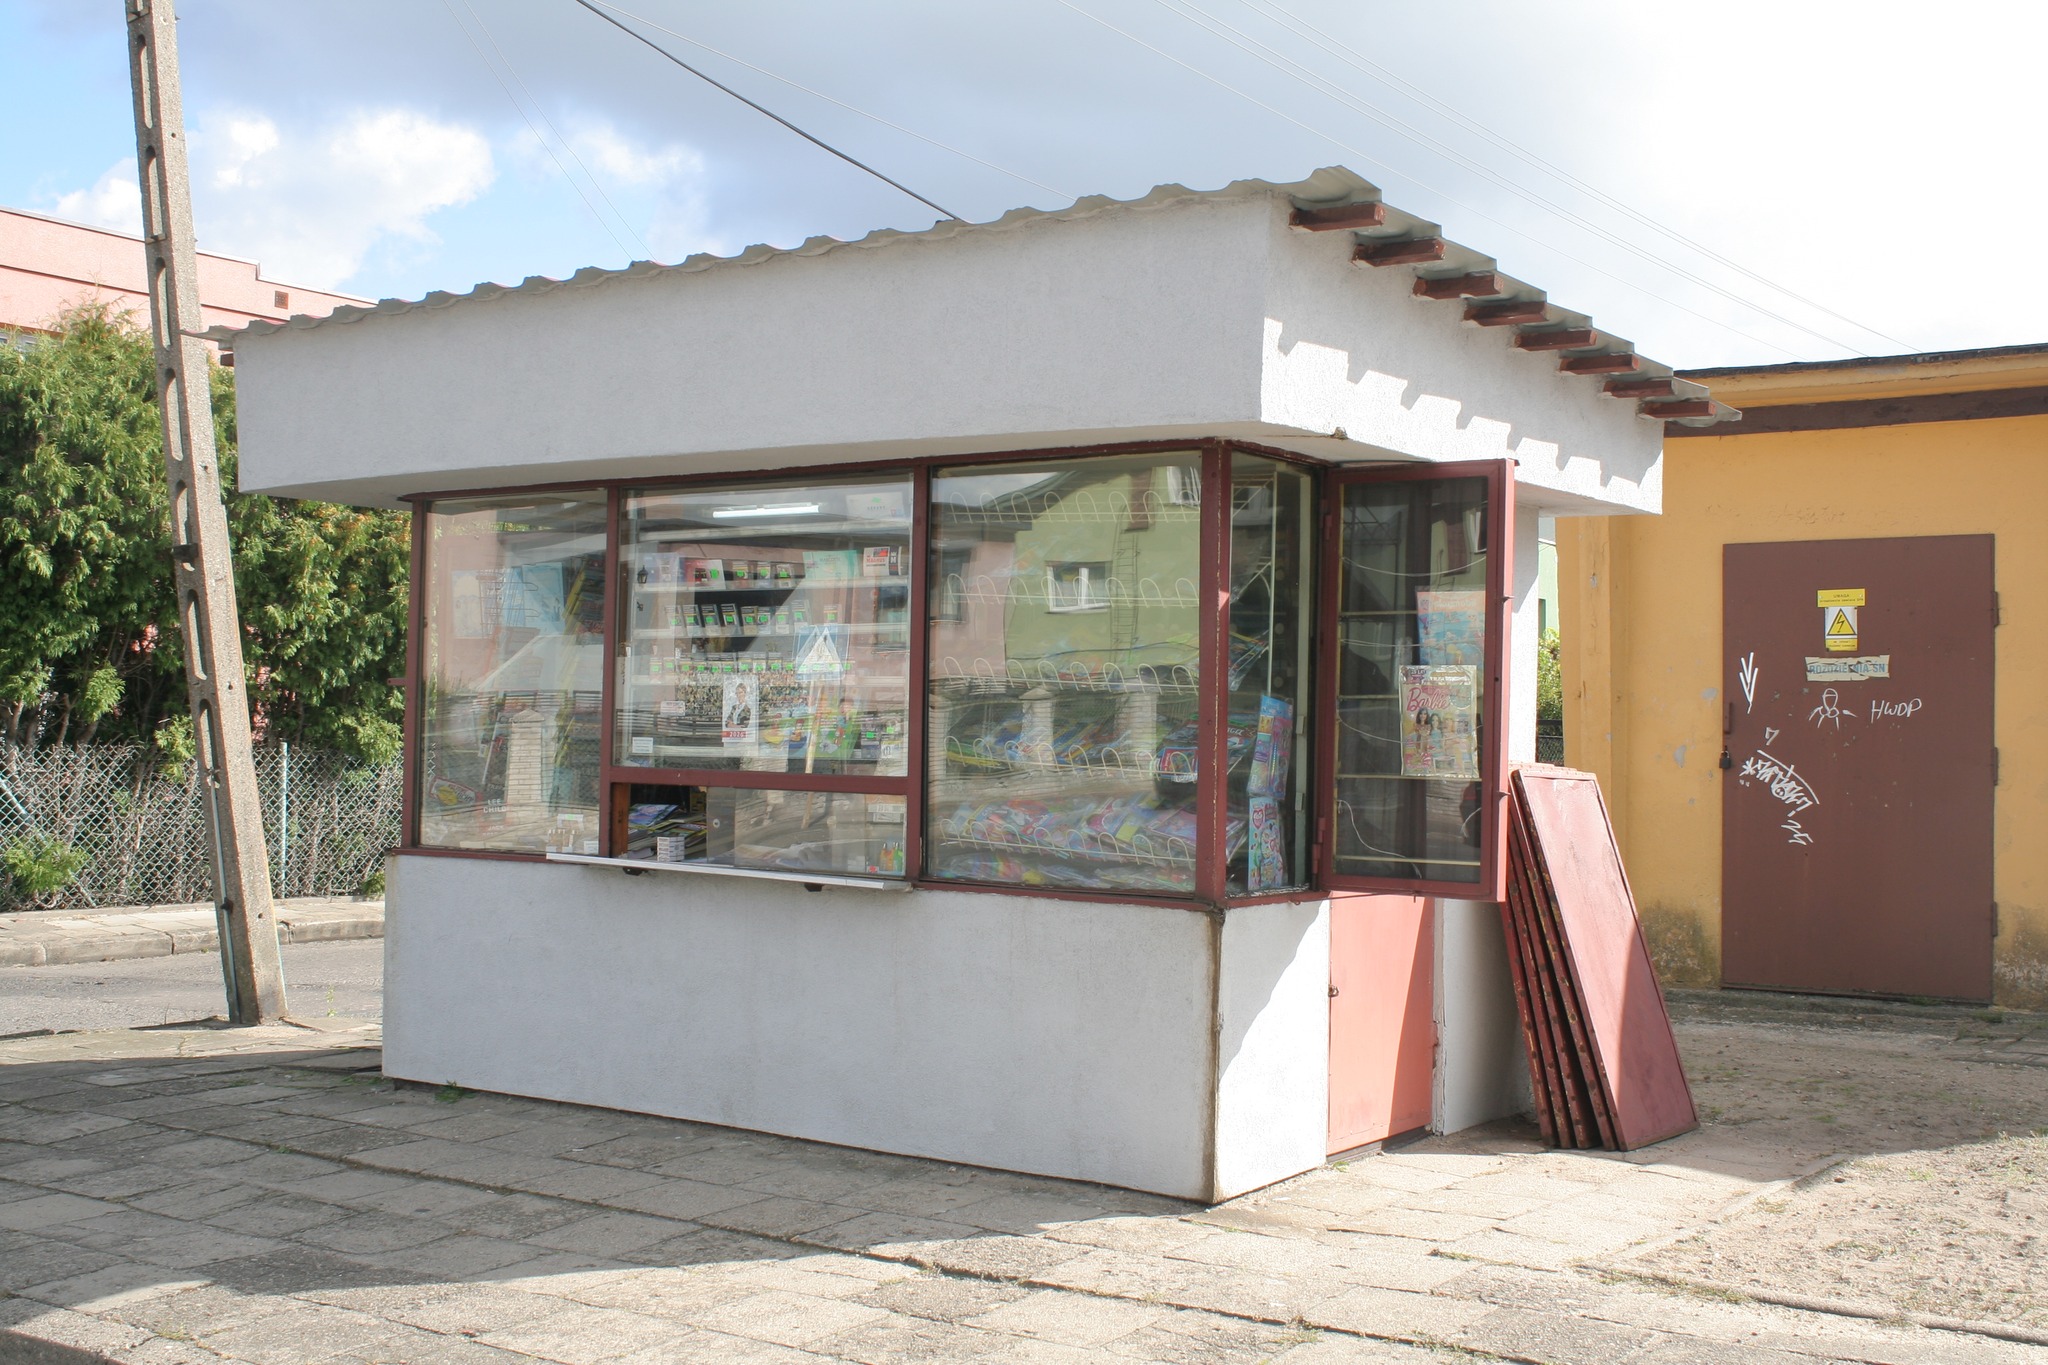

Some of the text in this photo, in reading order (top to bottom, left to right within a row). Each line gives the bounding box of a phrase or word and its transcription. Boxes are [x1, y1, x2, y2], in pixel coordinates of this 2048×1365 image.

[1808, 663, 1869, 674] ROZDZIENIA
[1406, 686, 1450, 712] Barbie
[1870, 697, 1922, 724] HWDP
[487, 798, 502, 806] LEE
[483, 805, 507, 814] CHILD
